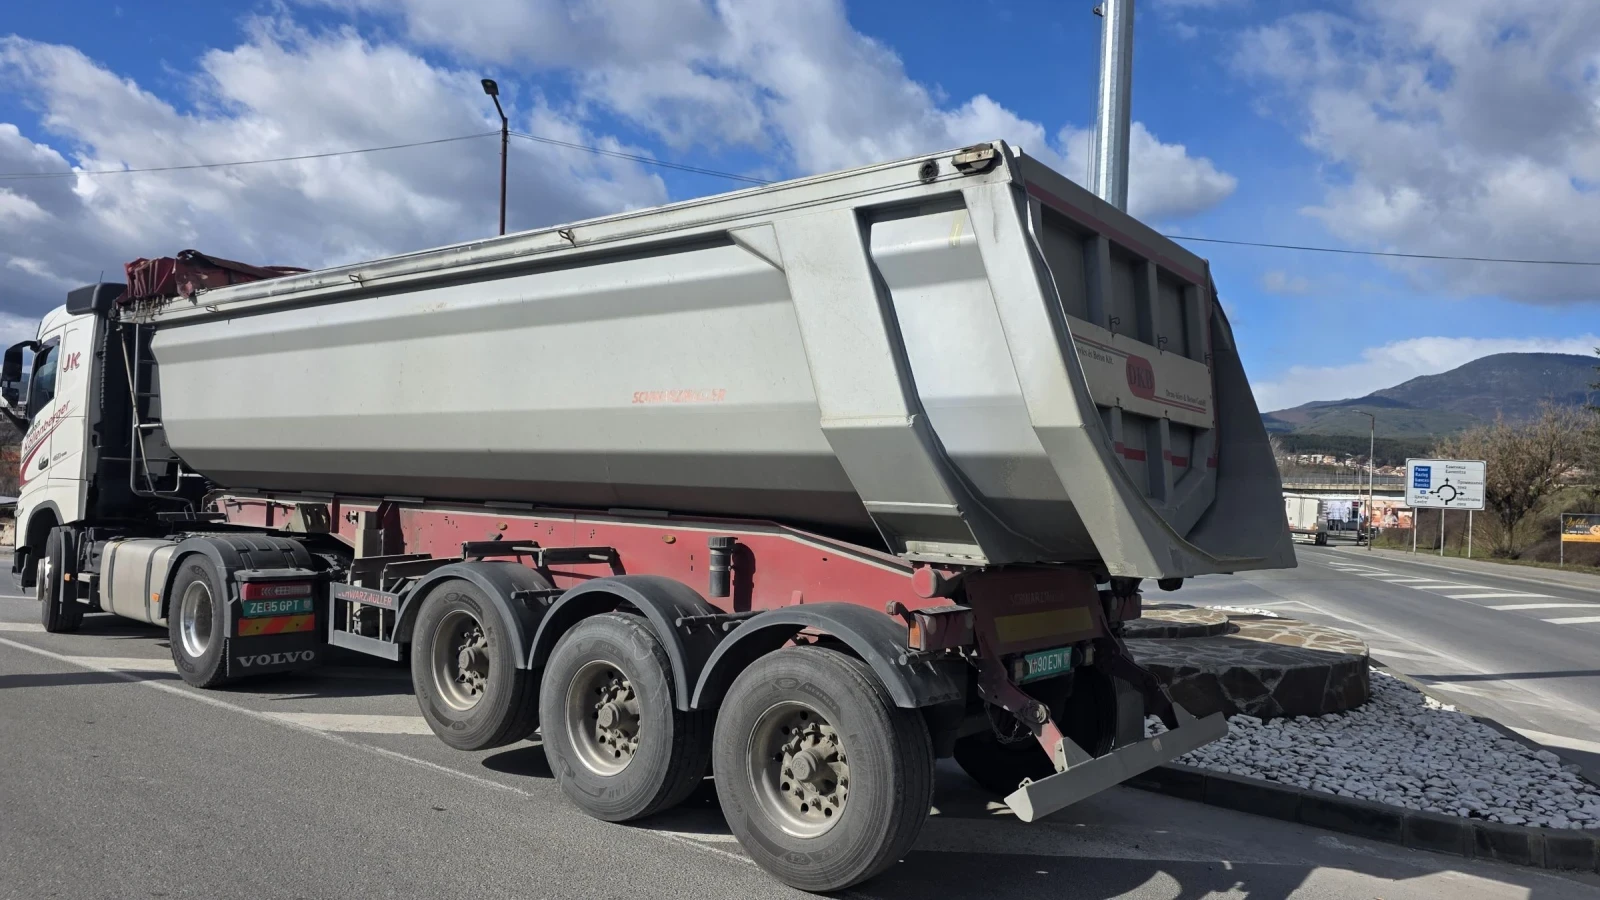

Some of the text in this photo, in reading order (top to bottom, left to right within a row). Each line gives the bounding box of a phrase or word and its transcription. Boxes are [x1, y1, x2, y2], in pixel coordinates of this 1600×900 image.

[63, 351, 81, 373] JK
[279, 599, 299, 611] GPT
[236, 650, 315, 668] VOLVO
